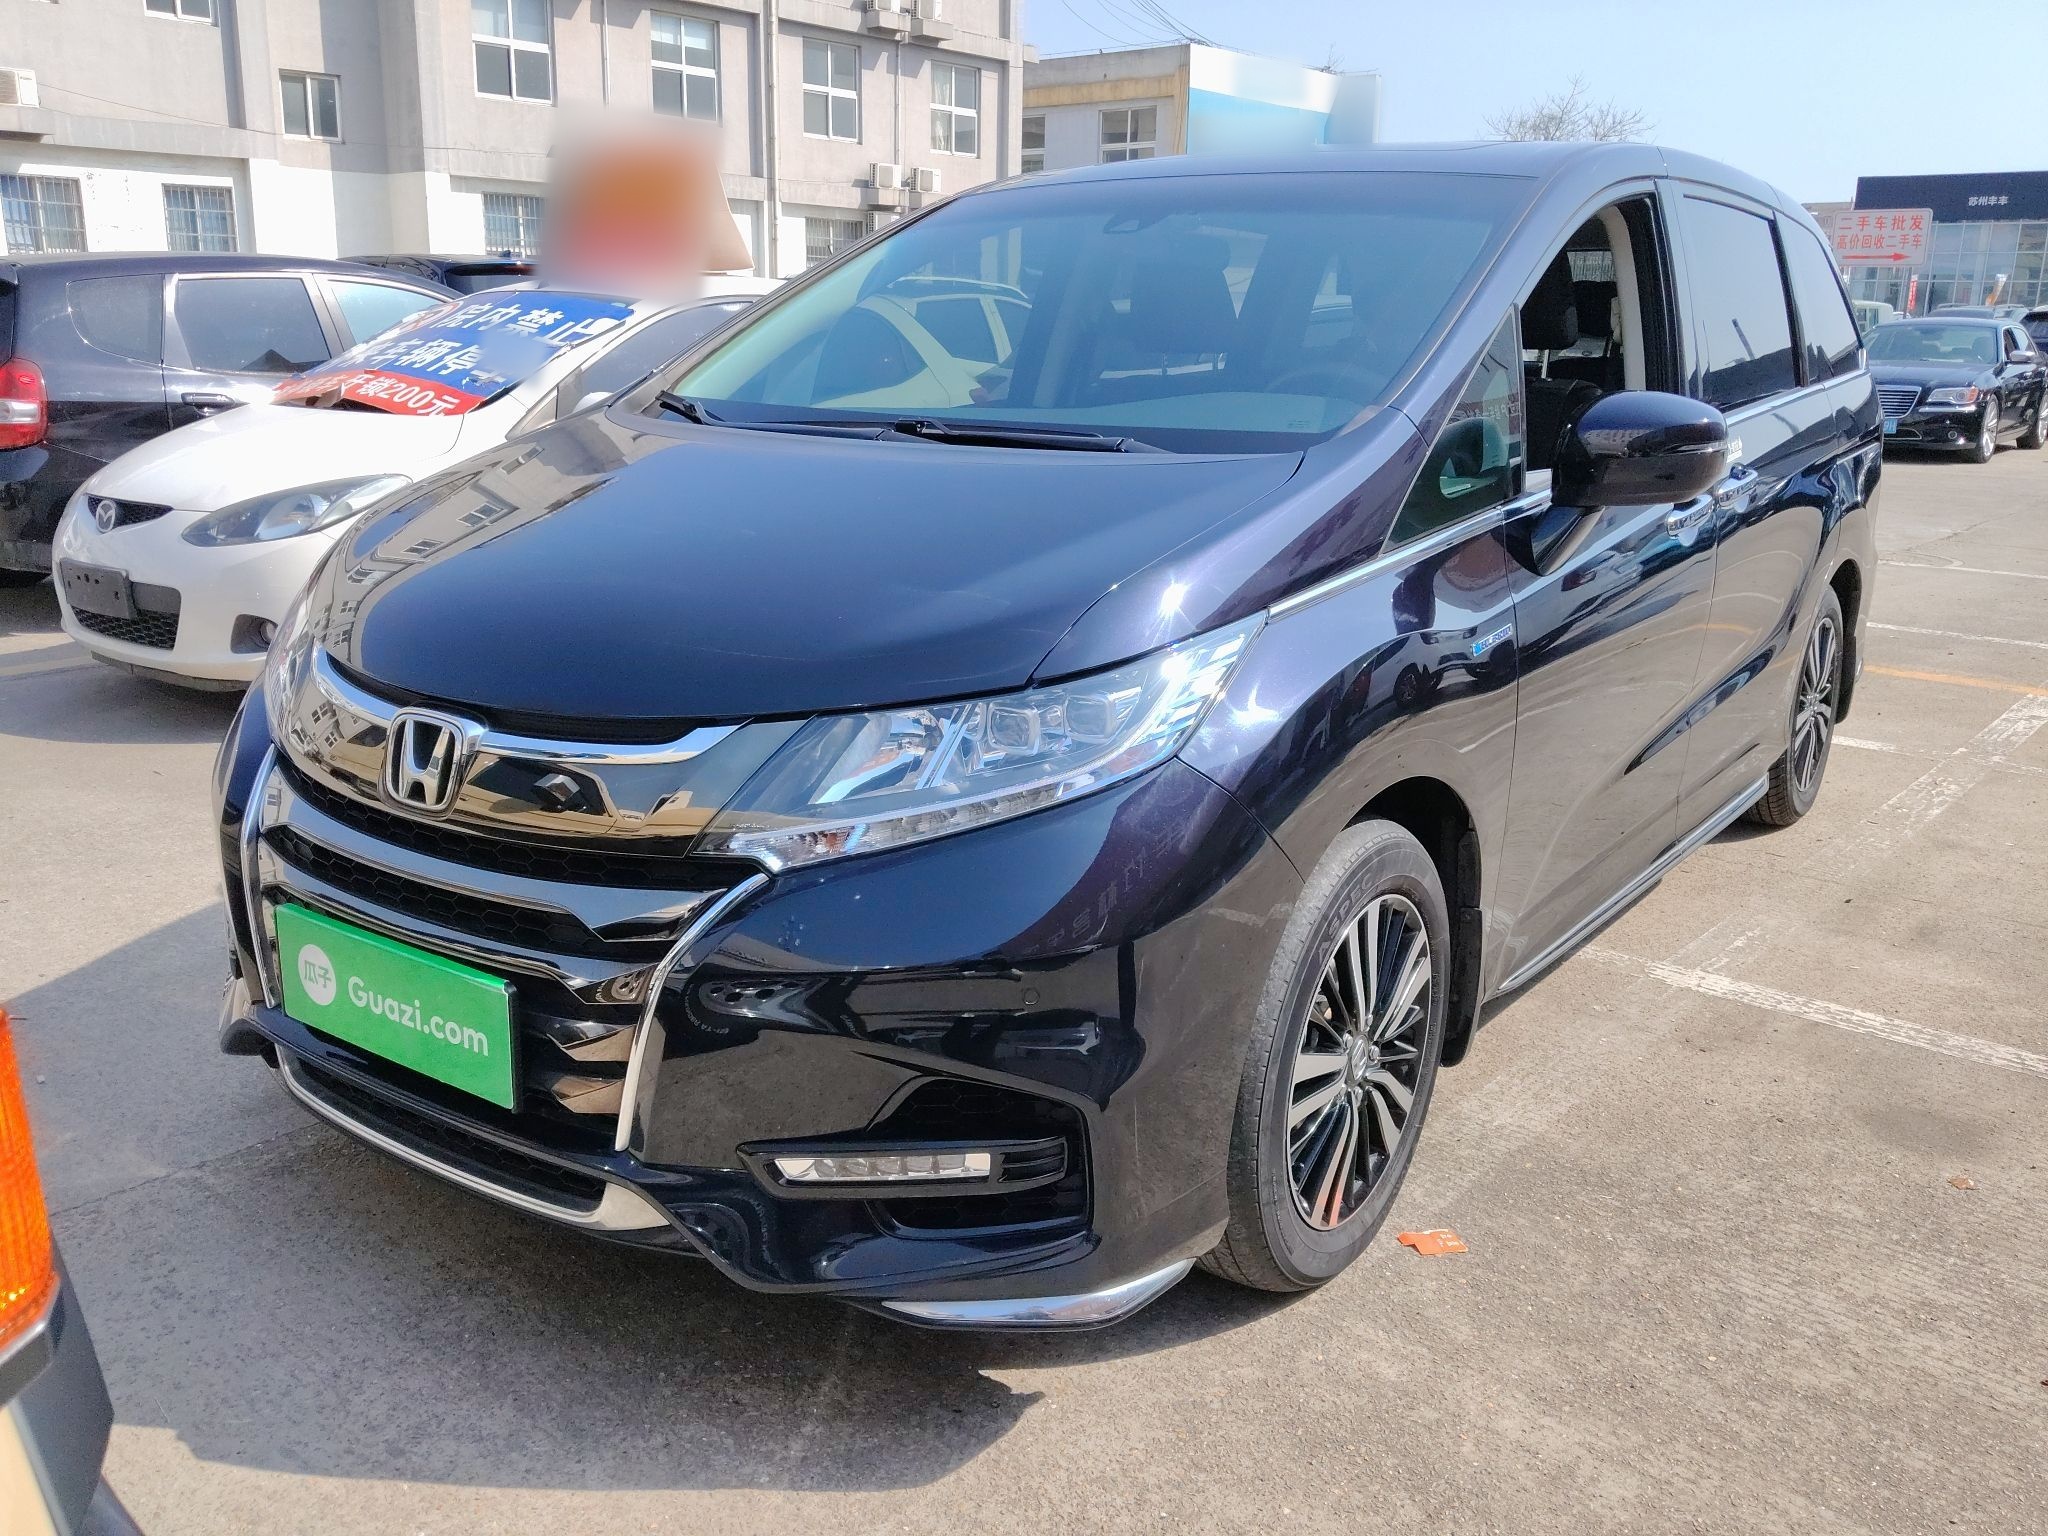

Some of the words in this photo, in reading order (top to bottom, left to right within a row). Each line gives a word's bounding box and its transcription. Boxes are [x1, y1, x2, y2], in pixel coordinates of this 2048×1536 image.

[1839, 214, 1923, 231] 二手车批发
[1836, 233, 1922, 250] 高价回收二手车
[430, 302, 597, 347] 院内禁止
[303, 959, 332, 988] 瓜子
[347, 976, 489, 1057] Guazi.com
